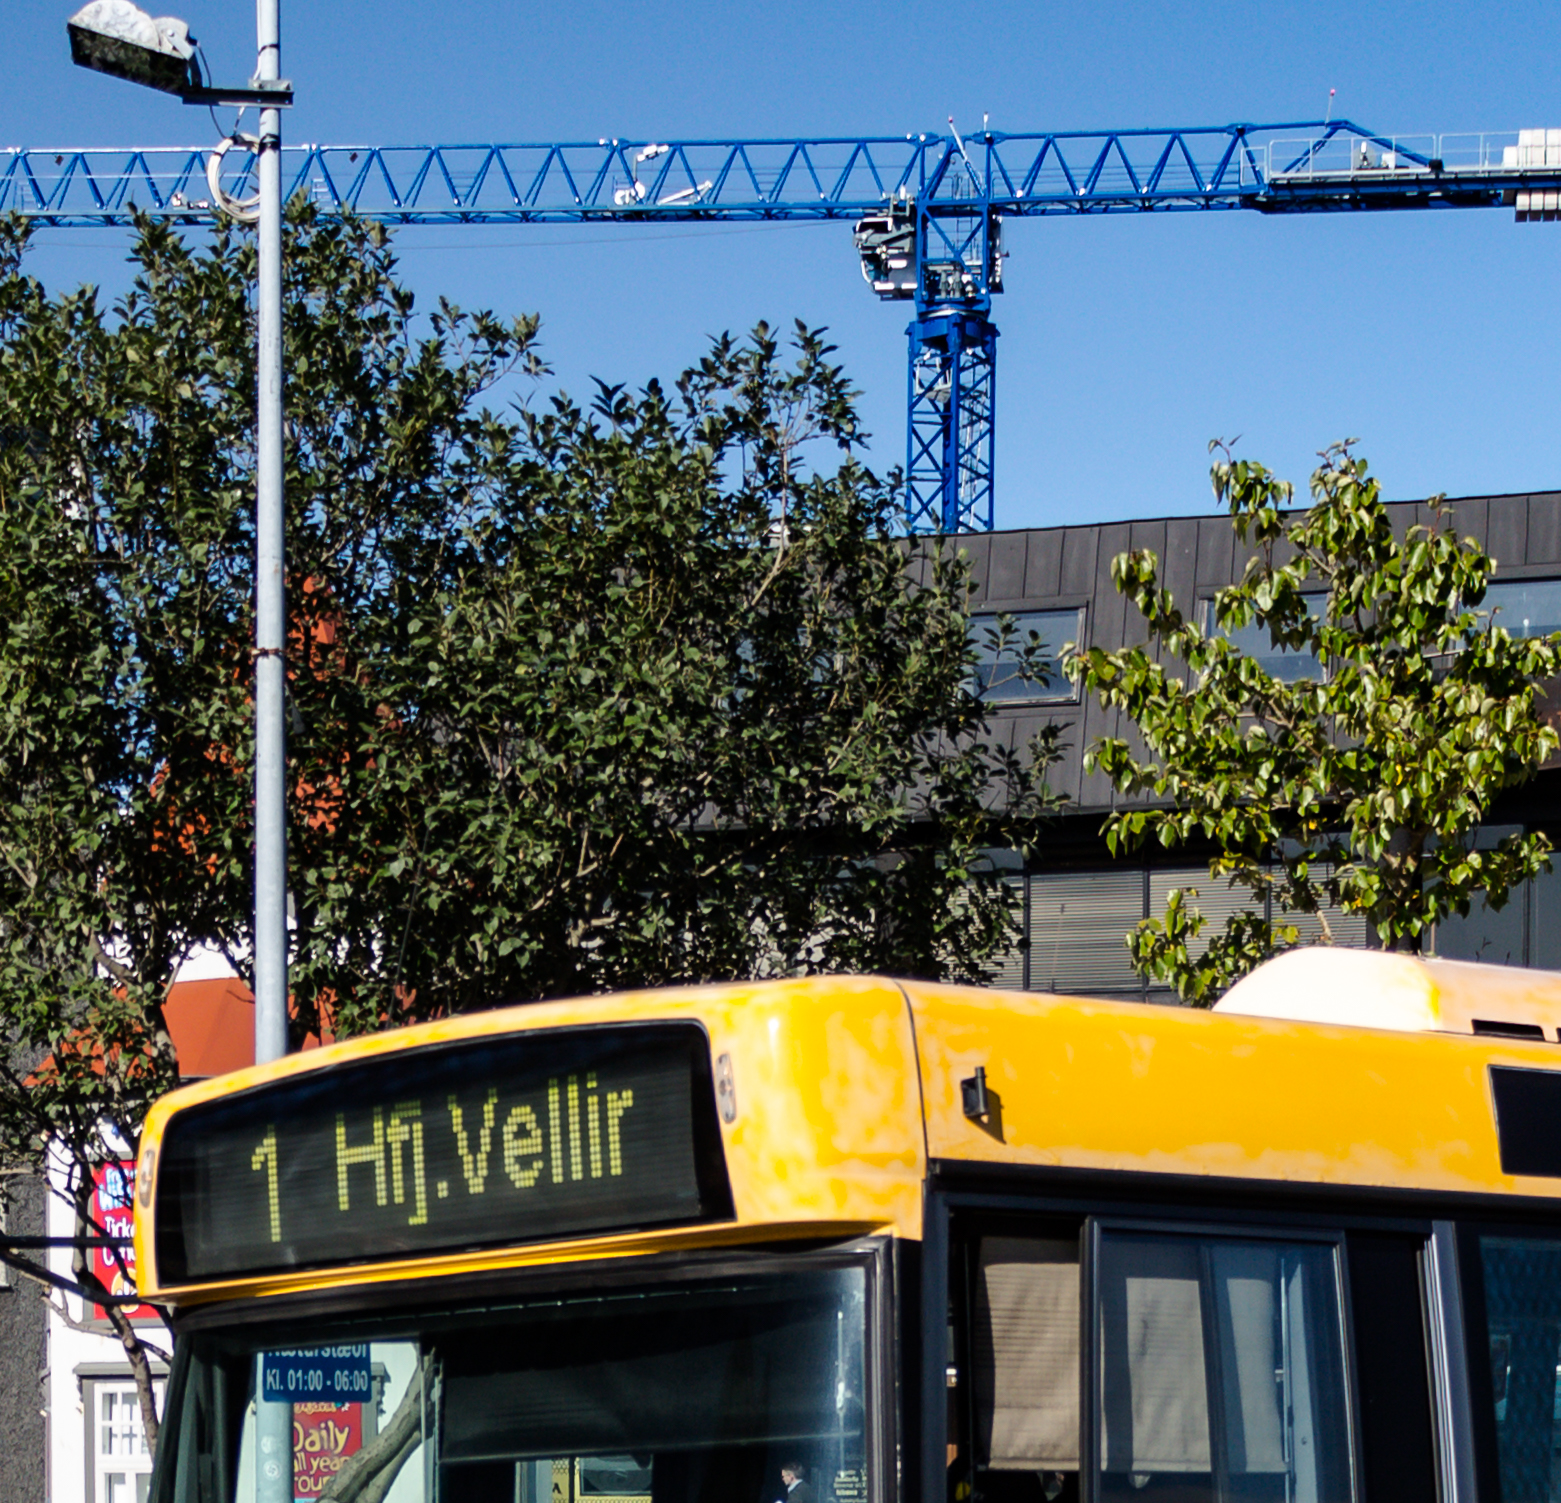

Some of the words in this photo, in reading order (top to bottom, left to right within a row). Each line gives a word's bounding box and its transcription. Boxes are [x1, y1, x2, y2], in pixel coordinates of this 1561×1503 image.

[252, 1124, 282, 1242] 1
[287, 1369, 323, 1391] 01:00
[334, 1369, 369, 1392] 06:00
